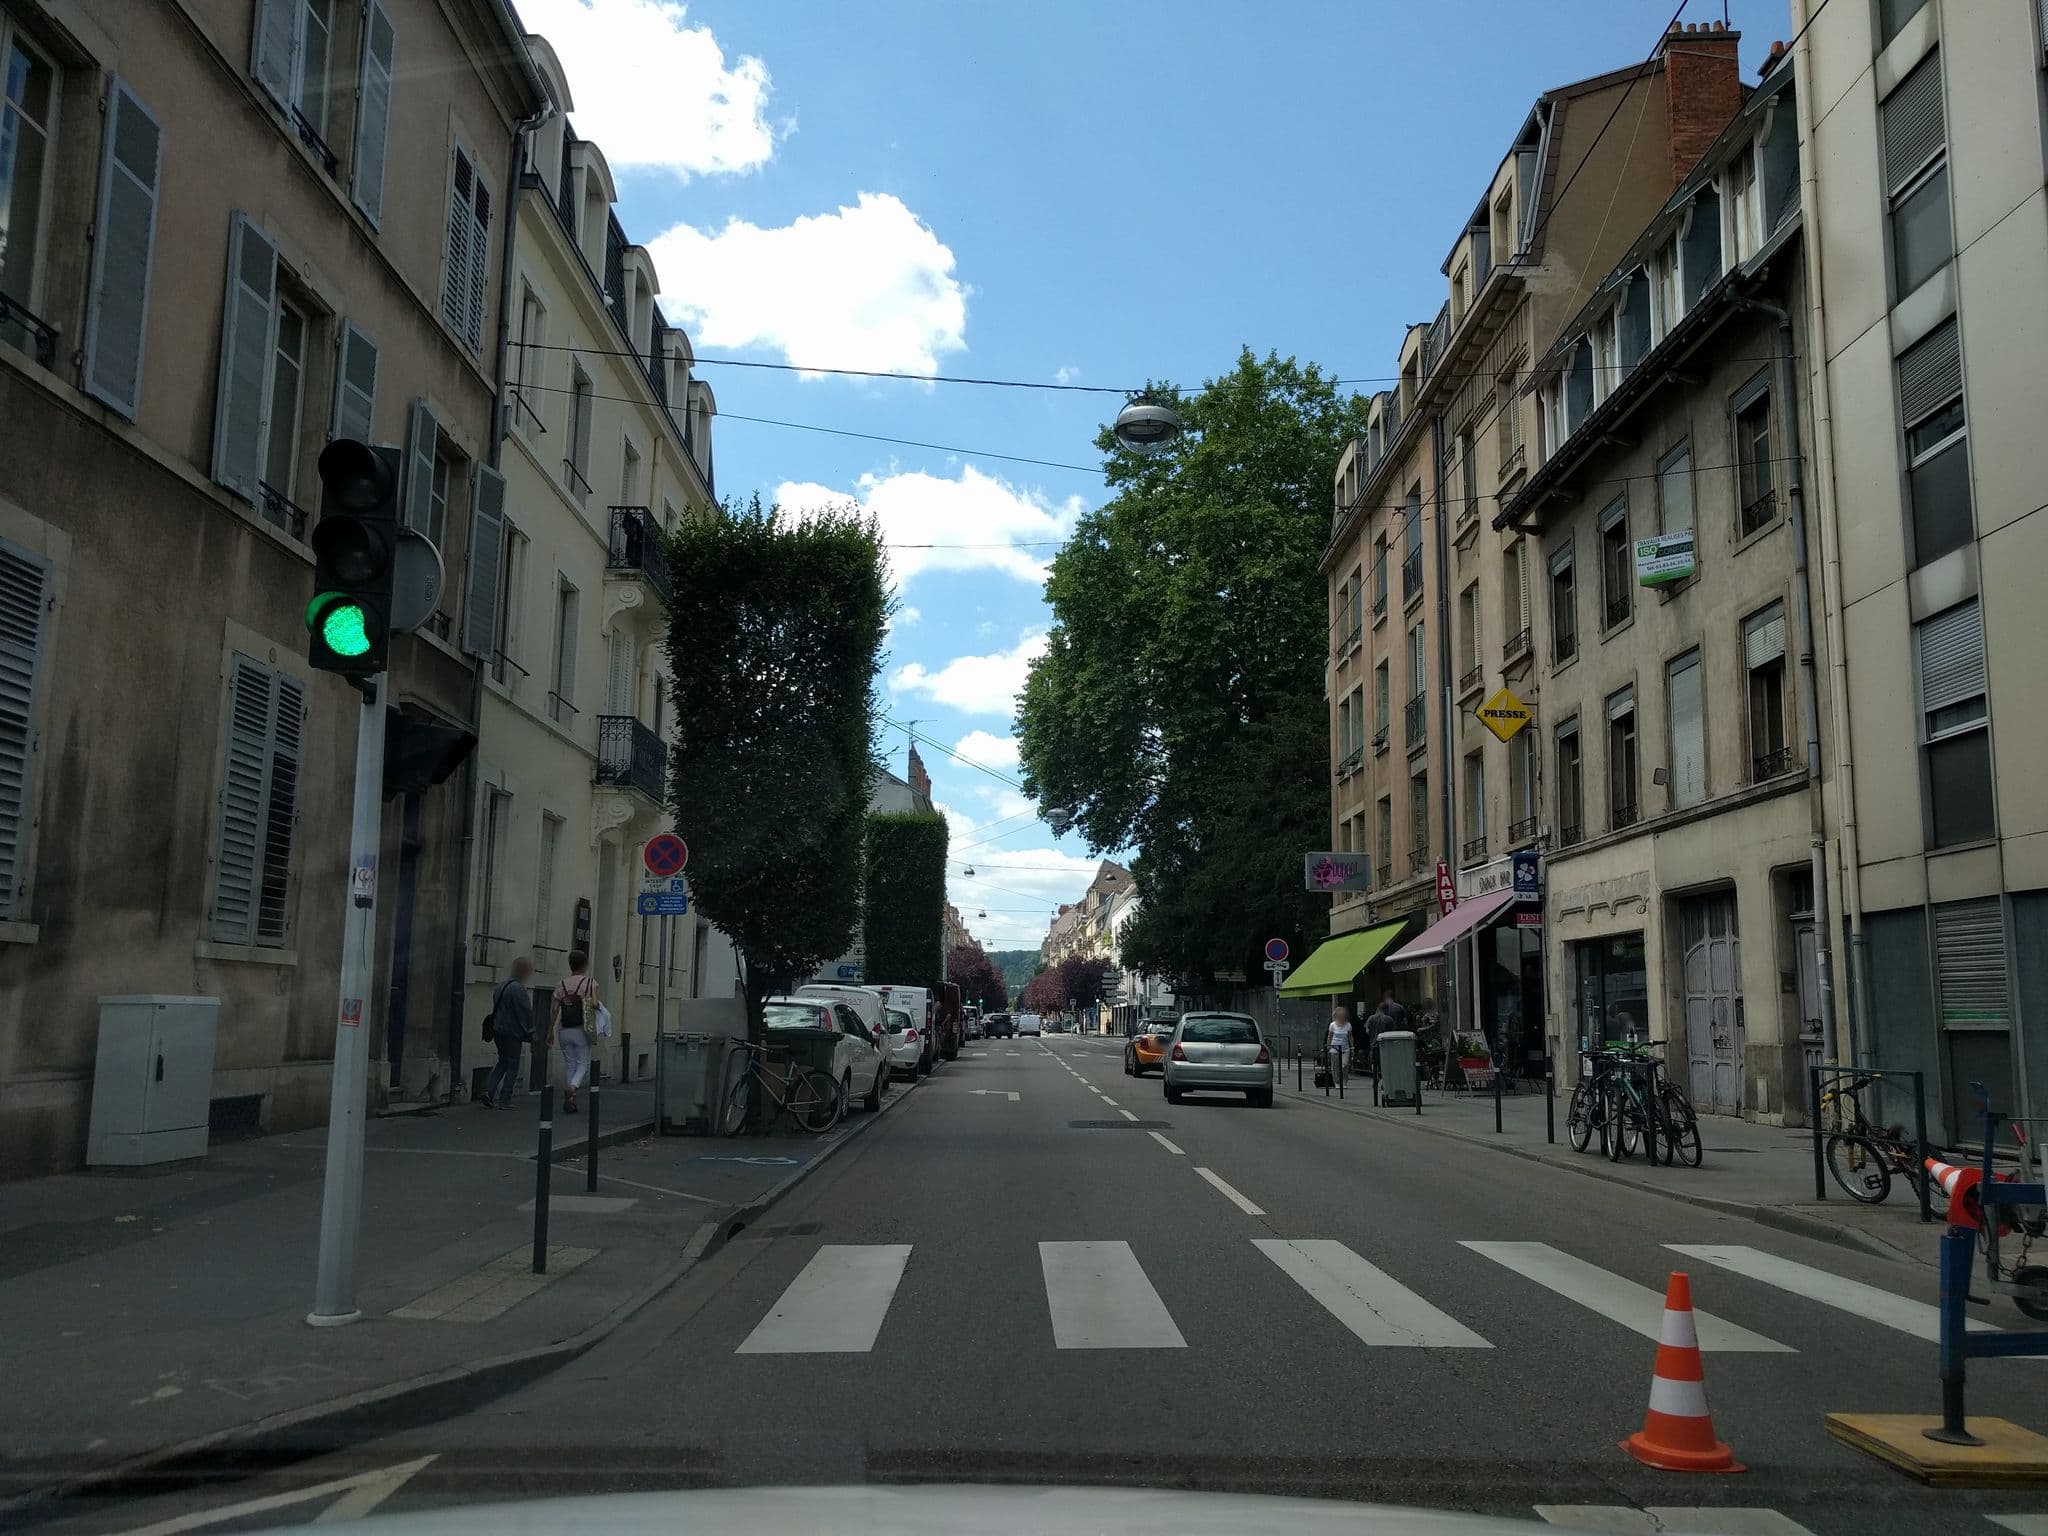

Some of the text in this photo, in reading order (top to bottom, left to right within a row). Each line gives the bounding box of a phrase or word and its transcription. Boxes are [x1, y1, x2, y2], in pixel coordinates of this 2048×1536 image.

[1639, 545, 1658, 556] ISO
[1484, 709, 1526, 719] PRESSE
[1438, 863, 1455, 913] TABA
